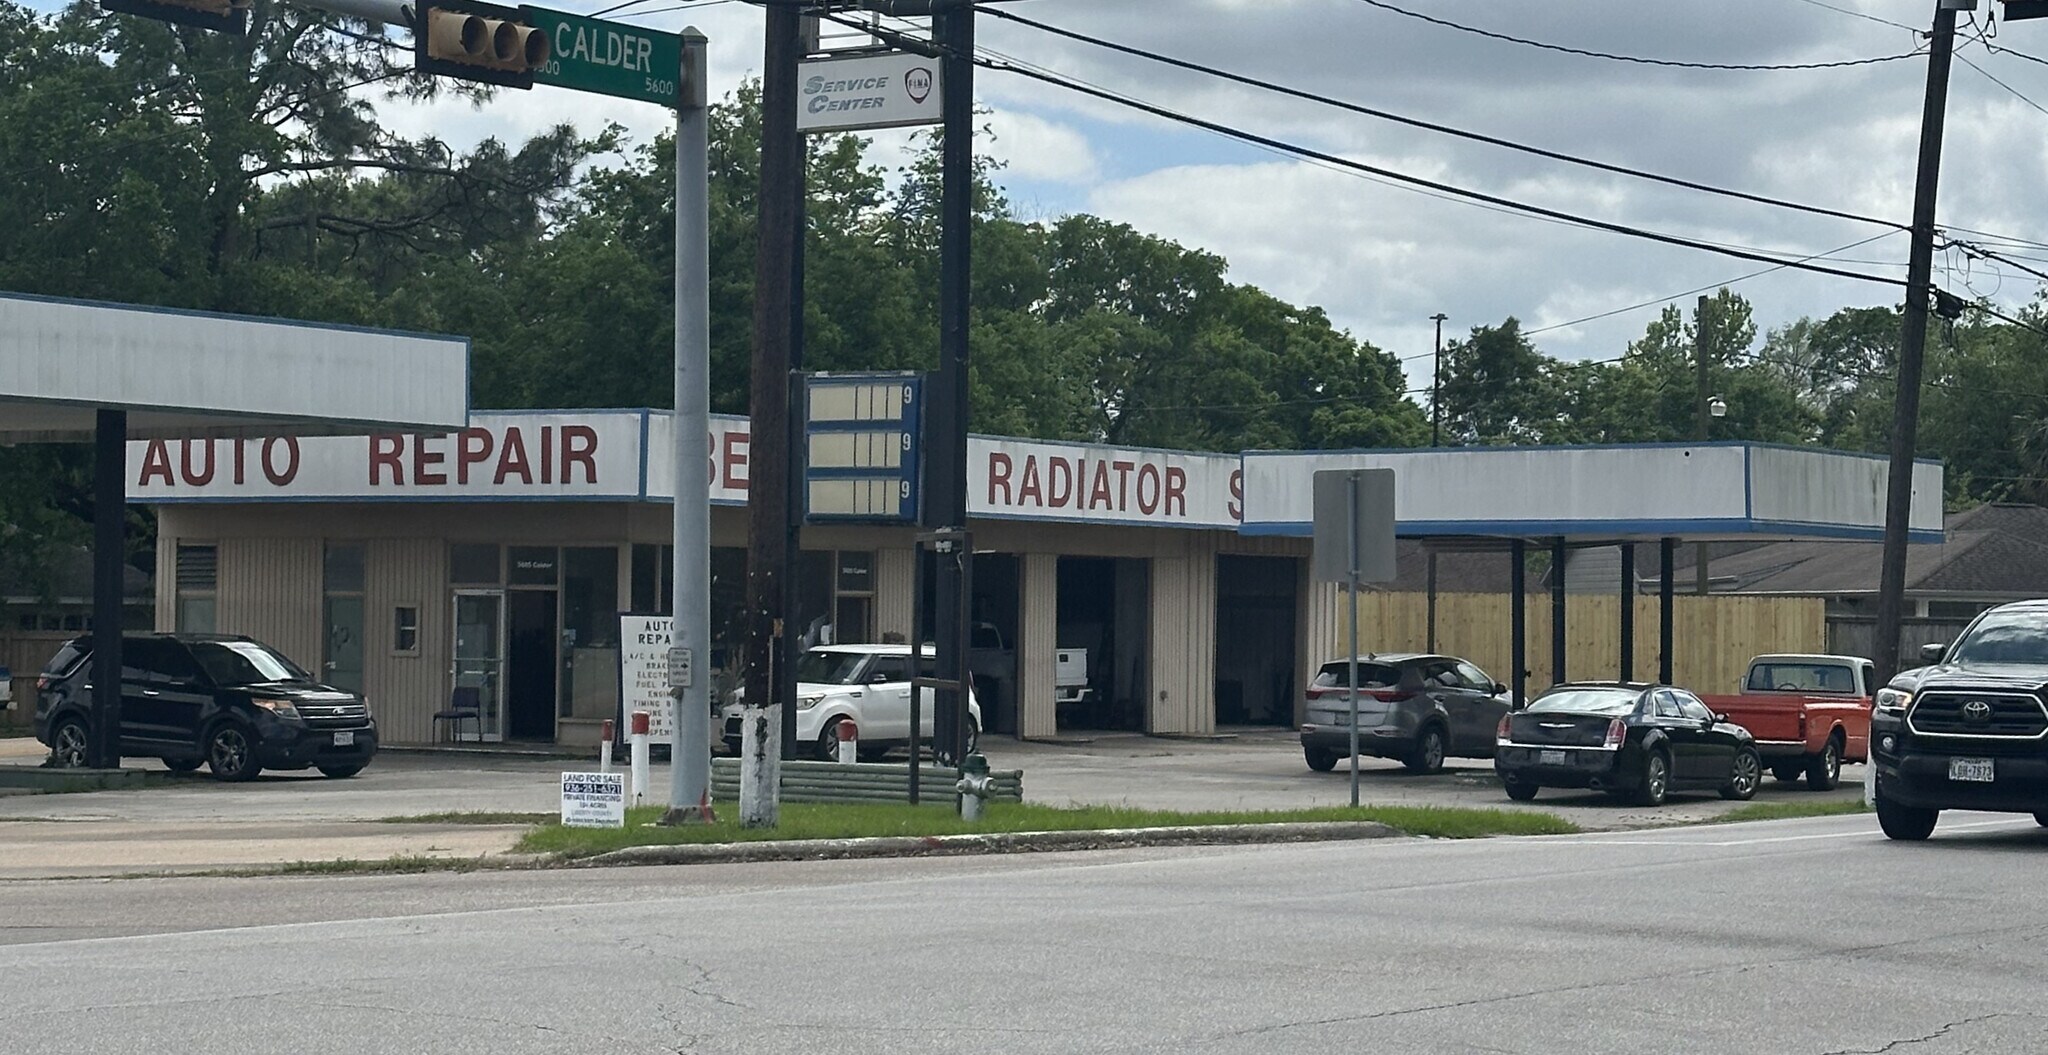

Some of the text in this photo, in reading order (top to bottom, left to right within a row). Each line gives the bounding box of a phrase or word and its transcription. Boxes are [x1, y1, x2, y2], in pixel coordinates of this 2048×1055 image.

[555, 22, 653, 73] CALDER
[645, 77, 674, 95] 5600
[803, 75, 889, 95] SERVICE
[807, 95, 885, 114] CENTER
[903, 386, 913, 404] 9
[902, 433, 912, 451] 9
[138, 426, 598, 487] AUTO REPAIR
[901, 481, 910, 498] 9
[988, 452, 1187, 517] RADIATOR
[564, 774, 621, 783] LAND FOR SALE
